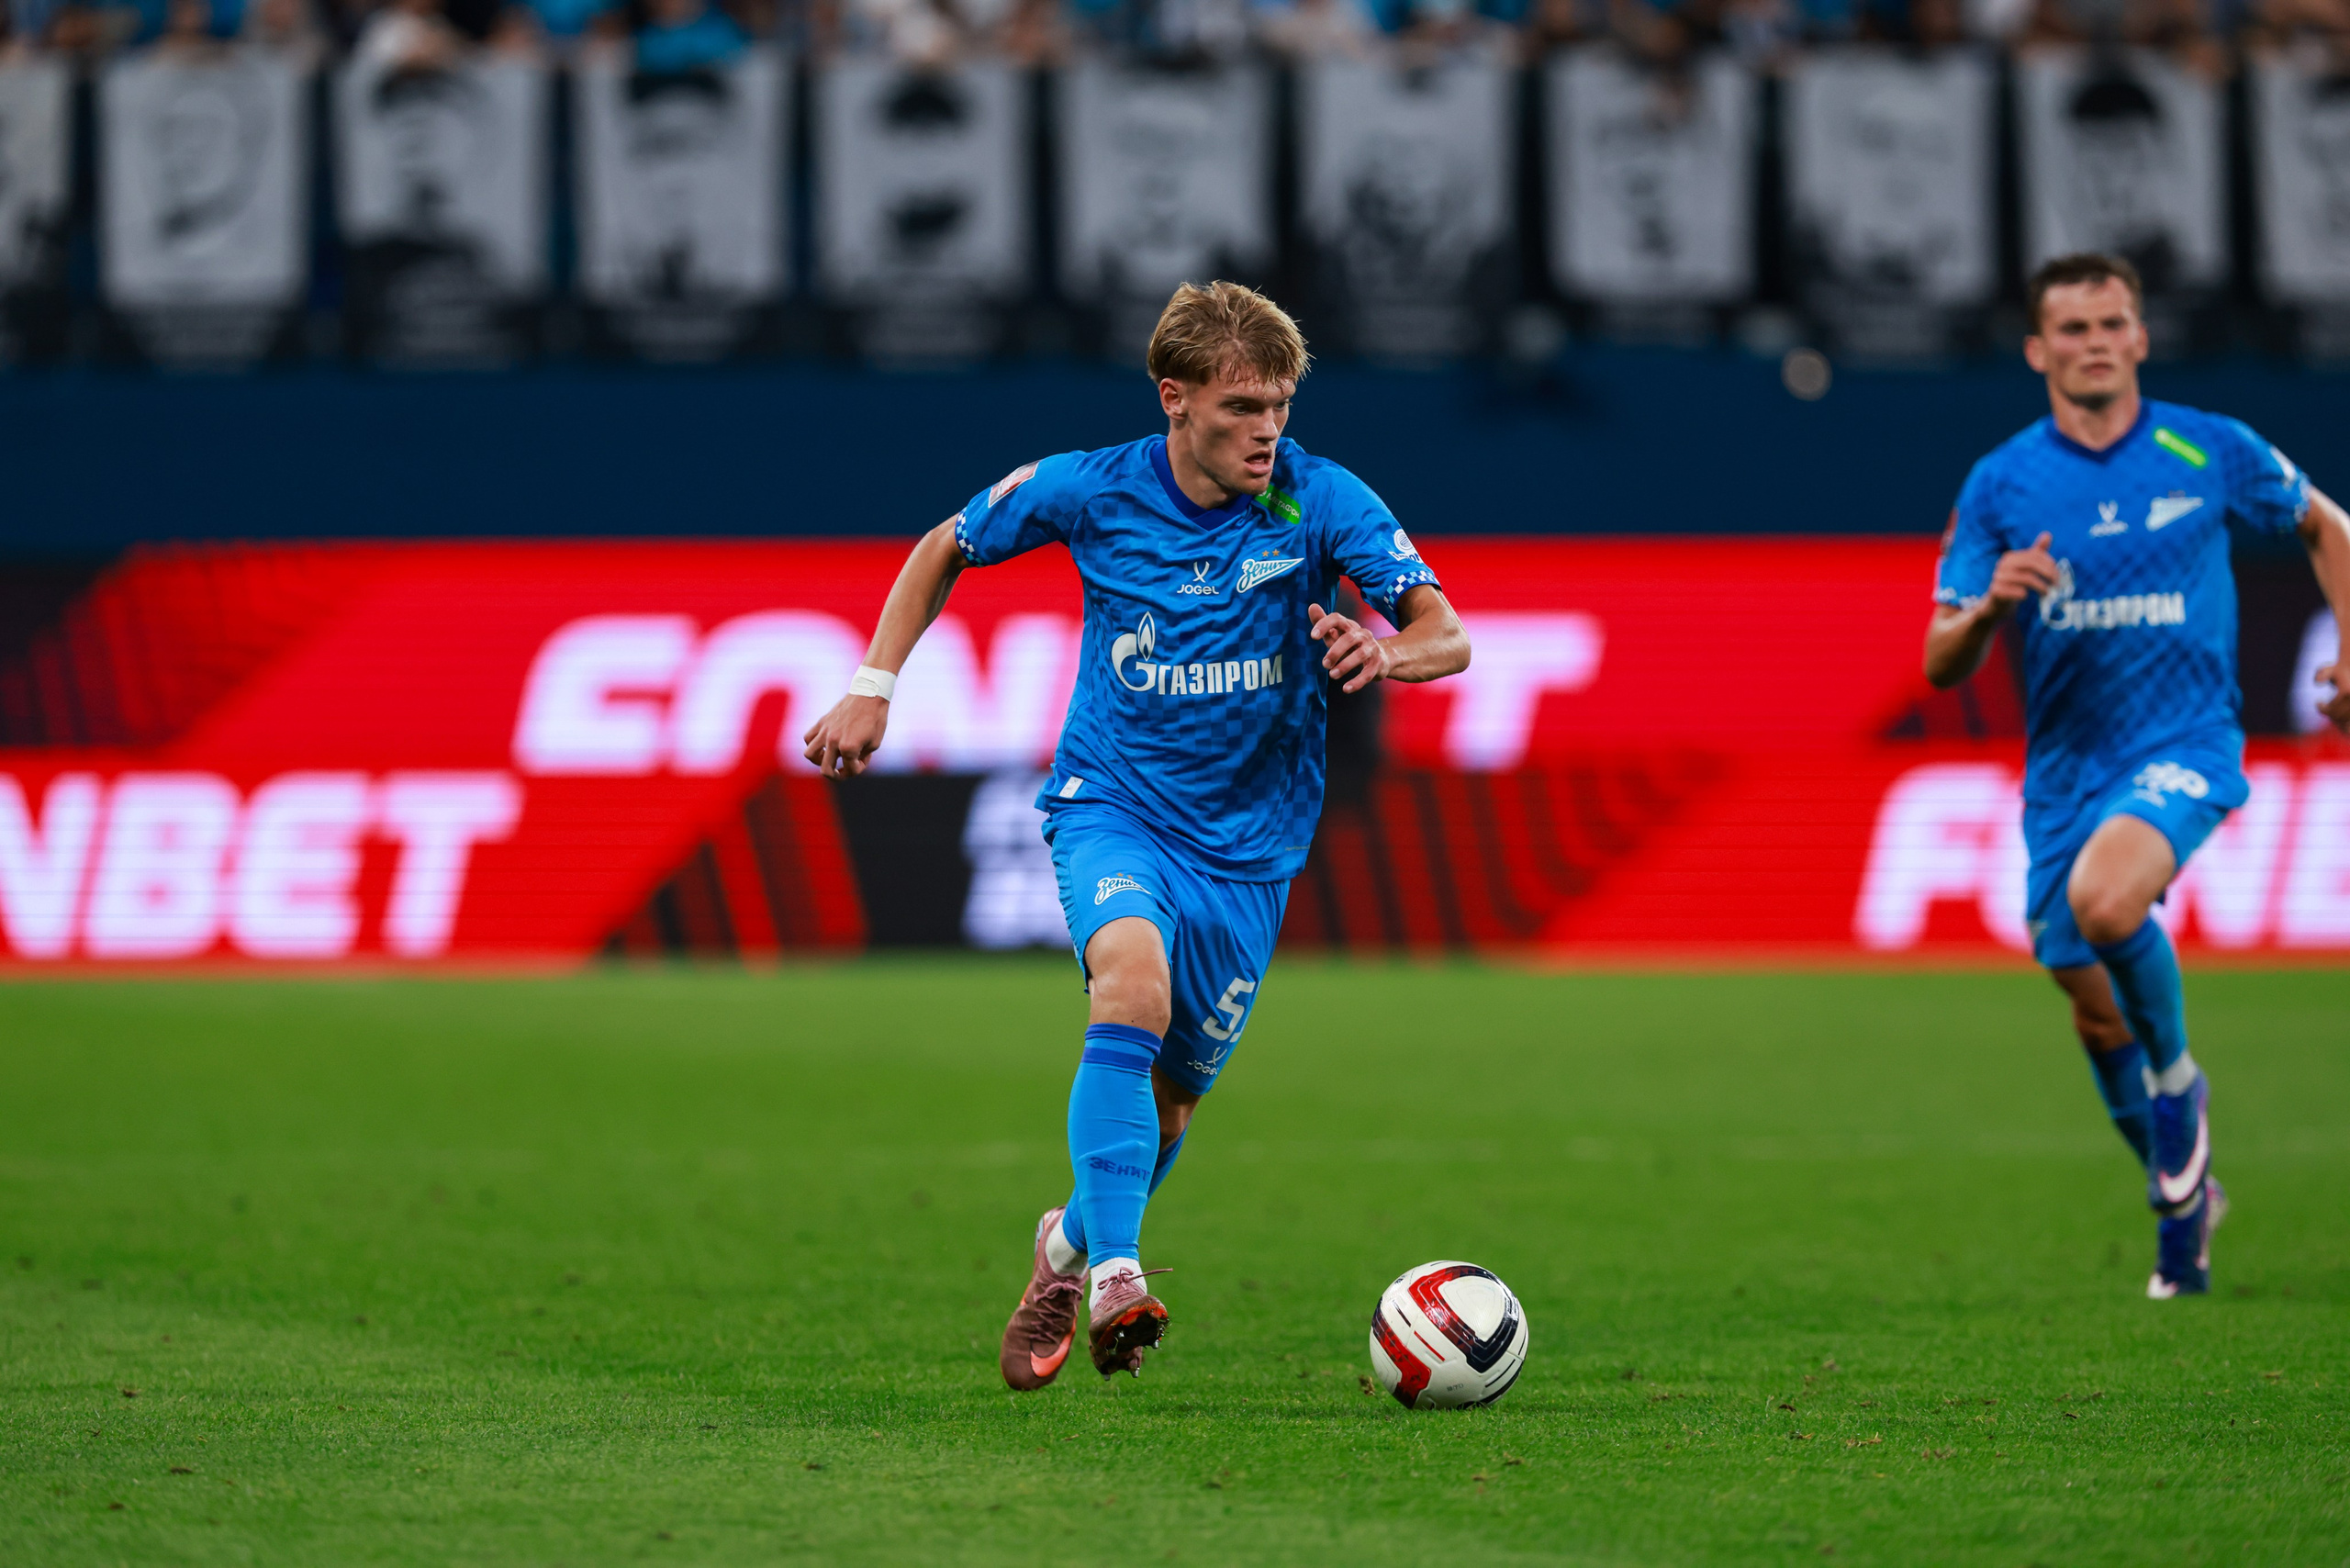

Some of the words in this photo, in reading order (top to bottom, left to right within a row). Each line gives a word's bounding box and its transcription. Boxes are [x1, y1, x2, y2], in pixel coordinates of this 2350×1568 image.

[1158, 654, 1283, 695] ГАЗПРОМ
[1202, 977, 1261, 1043] 5
[1089, 1157, 1151, 1182] ЗЕНИТ
